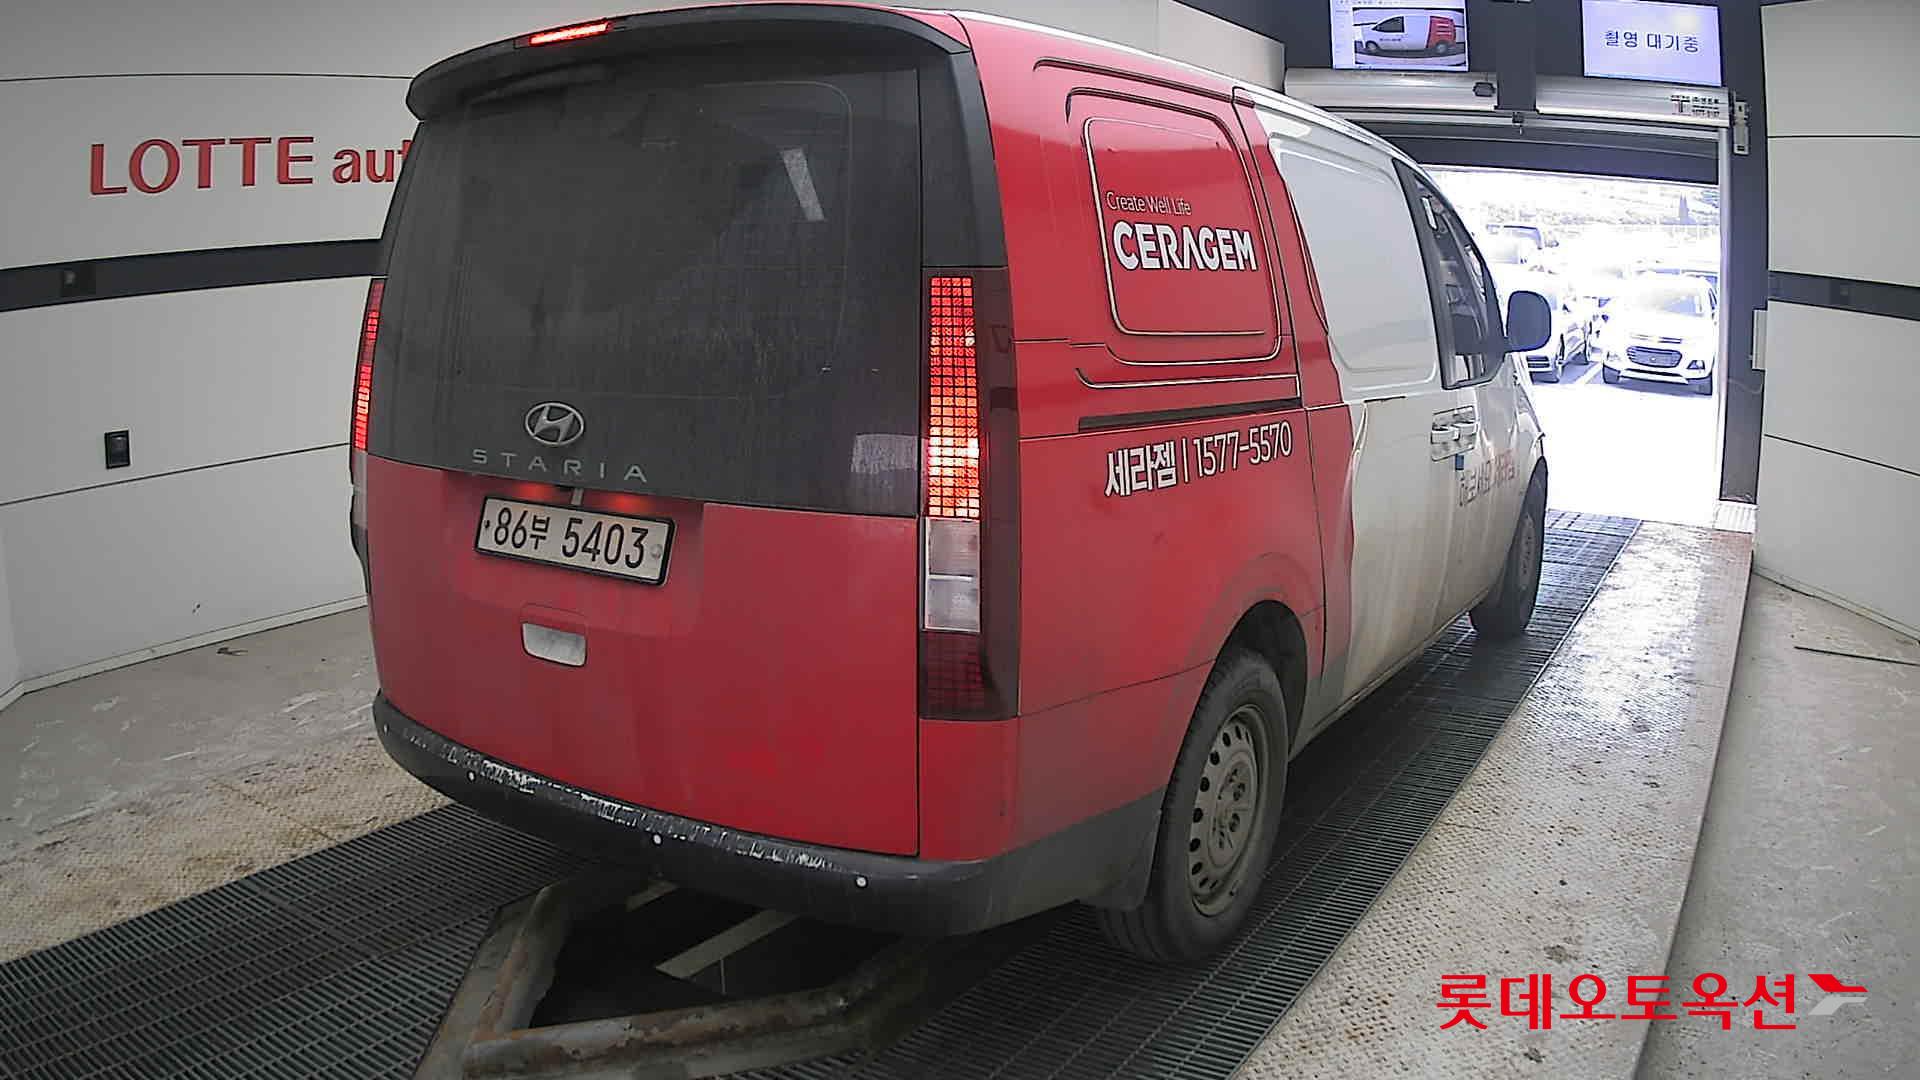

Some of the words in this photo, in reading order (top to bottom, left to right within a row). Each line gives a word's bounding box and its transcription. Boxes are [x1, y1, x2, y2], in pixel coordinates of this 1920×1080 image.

[1646, 33, 1698, 53] 대기중
[90, 136, 314, 195] LOTTE
[1106, 191, 1145, 212] Create
[1145, 196, 1172, 214] Well
[1171, 198, 1192, 216] Life
[1113, 221, 1257, 270] CERAGEM
[473, 449, 647, 482] STARIA
[1104, 441, 1177, 496] 세라젬
[1193, 421, 1292, 477] 1577-5570
[494, 507, 550, 550] 86부
[562, 517, 649, 569] 5403
